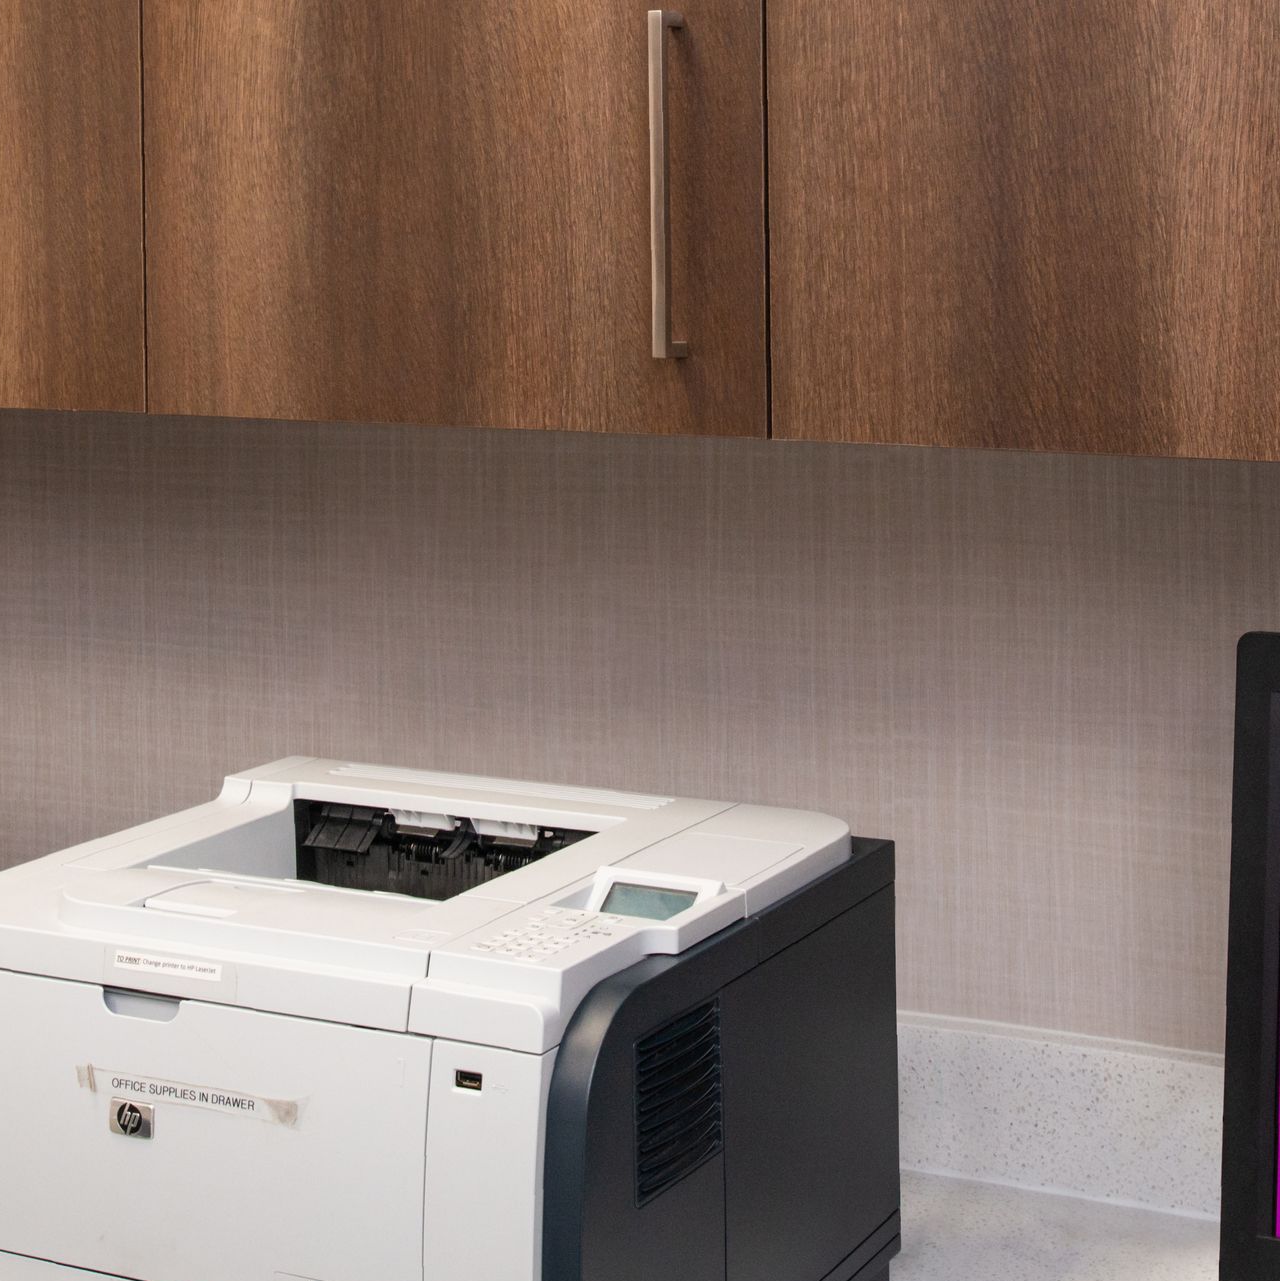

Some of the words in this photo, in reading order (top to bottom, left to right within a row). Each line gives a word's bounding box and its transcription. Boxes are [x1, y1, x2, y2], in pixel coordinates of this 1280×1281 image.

[142, 958, 162, 968] Change
[162, 960, 180, 971] printer
[180, 962, 186, 970] to
[187, 963, 195, 971] HP
[195, 964, 216, 975] LaserJet
[111, 1077, 146, 1093] OFFICE
[149, 1083, 197, 1101] SUPPLIES
[199, 1091, 209, 1103] IN
[211, 1093, 255, 1111] DRAWER
[120, 1102, 140, 1135] hp
